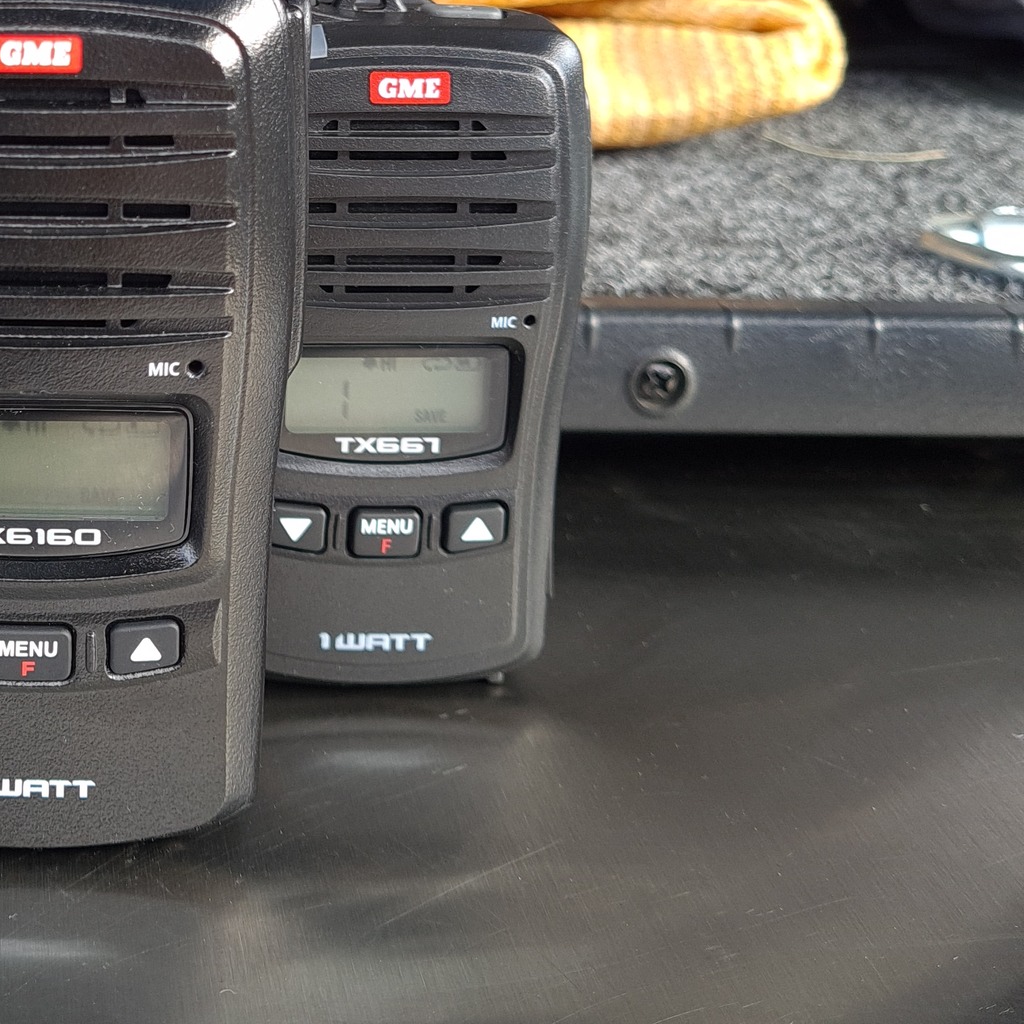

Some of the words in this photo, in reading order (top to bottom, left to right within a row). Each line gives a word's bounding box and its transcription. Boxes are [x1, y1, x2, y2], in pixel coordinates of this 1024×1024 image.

[0, 40, 72, 67] GME
[377, 77, 441, 99] GME
[491, 316, 518, 329] MIC
[148, 362, 181, 377] MIC
[414, 407, 448, 424] SAVE
[360, 518, 414, 535] MENU
[380, 538, 392, 554] F
[318, 631, 331, 651] 1
[334, 632, 434, 652] WATT
[20, 660, 36, 677] F
